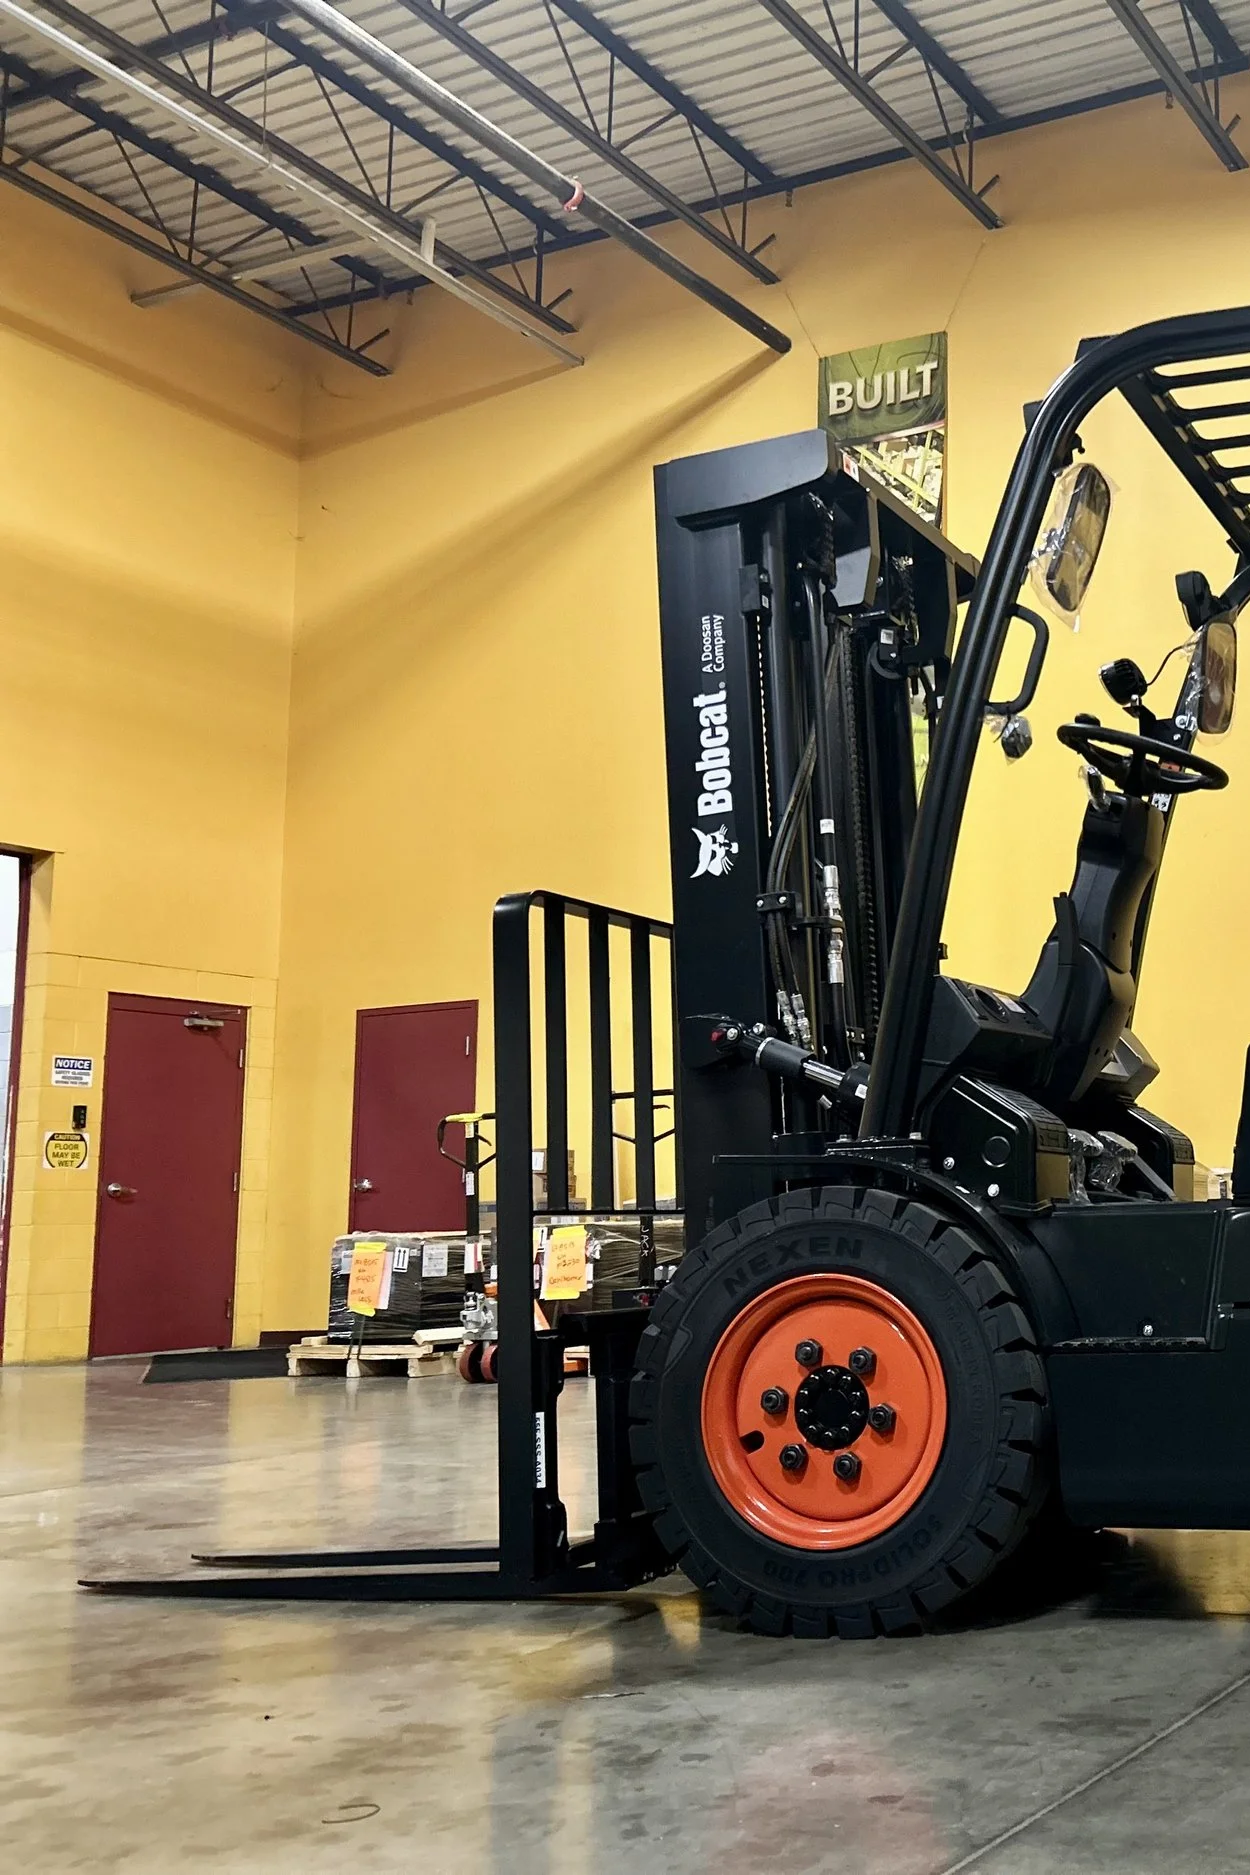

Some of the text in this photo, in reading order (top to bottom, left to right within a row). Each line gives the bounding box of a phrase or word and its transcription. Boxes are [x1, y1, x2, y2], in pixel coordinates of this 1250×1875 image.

[829, 361, 938, 416] BUILT
[701, 616, 714, 673] A Doosan
[713, 615, 726, 673] Company
[693, 689, 733, 816] Bobcat
[56, 1059, 91, 1069] NOTICE
[52, 1151, 69, 1159] MAY
[54, 1143, 79, 1151] FLOOR
[722, 1236, 864, 1298] NEXEN
